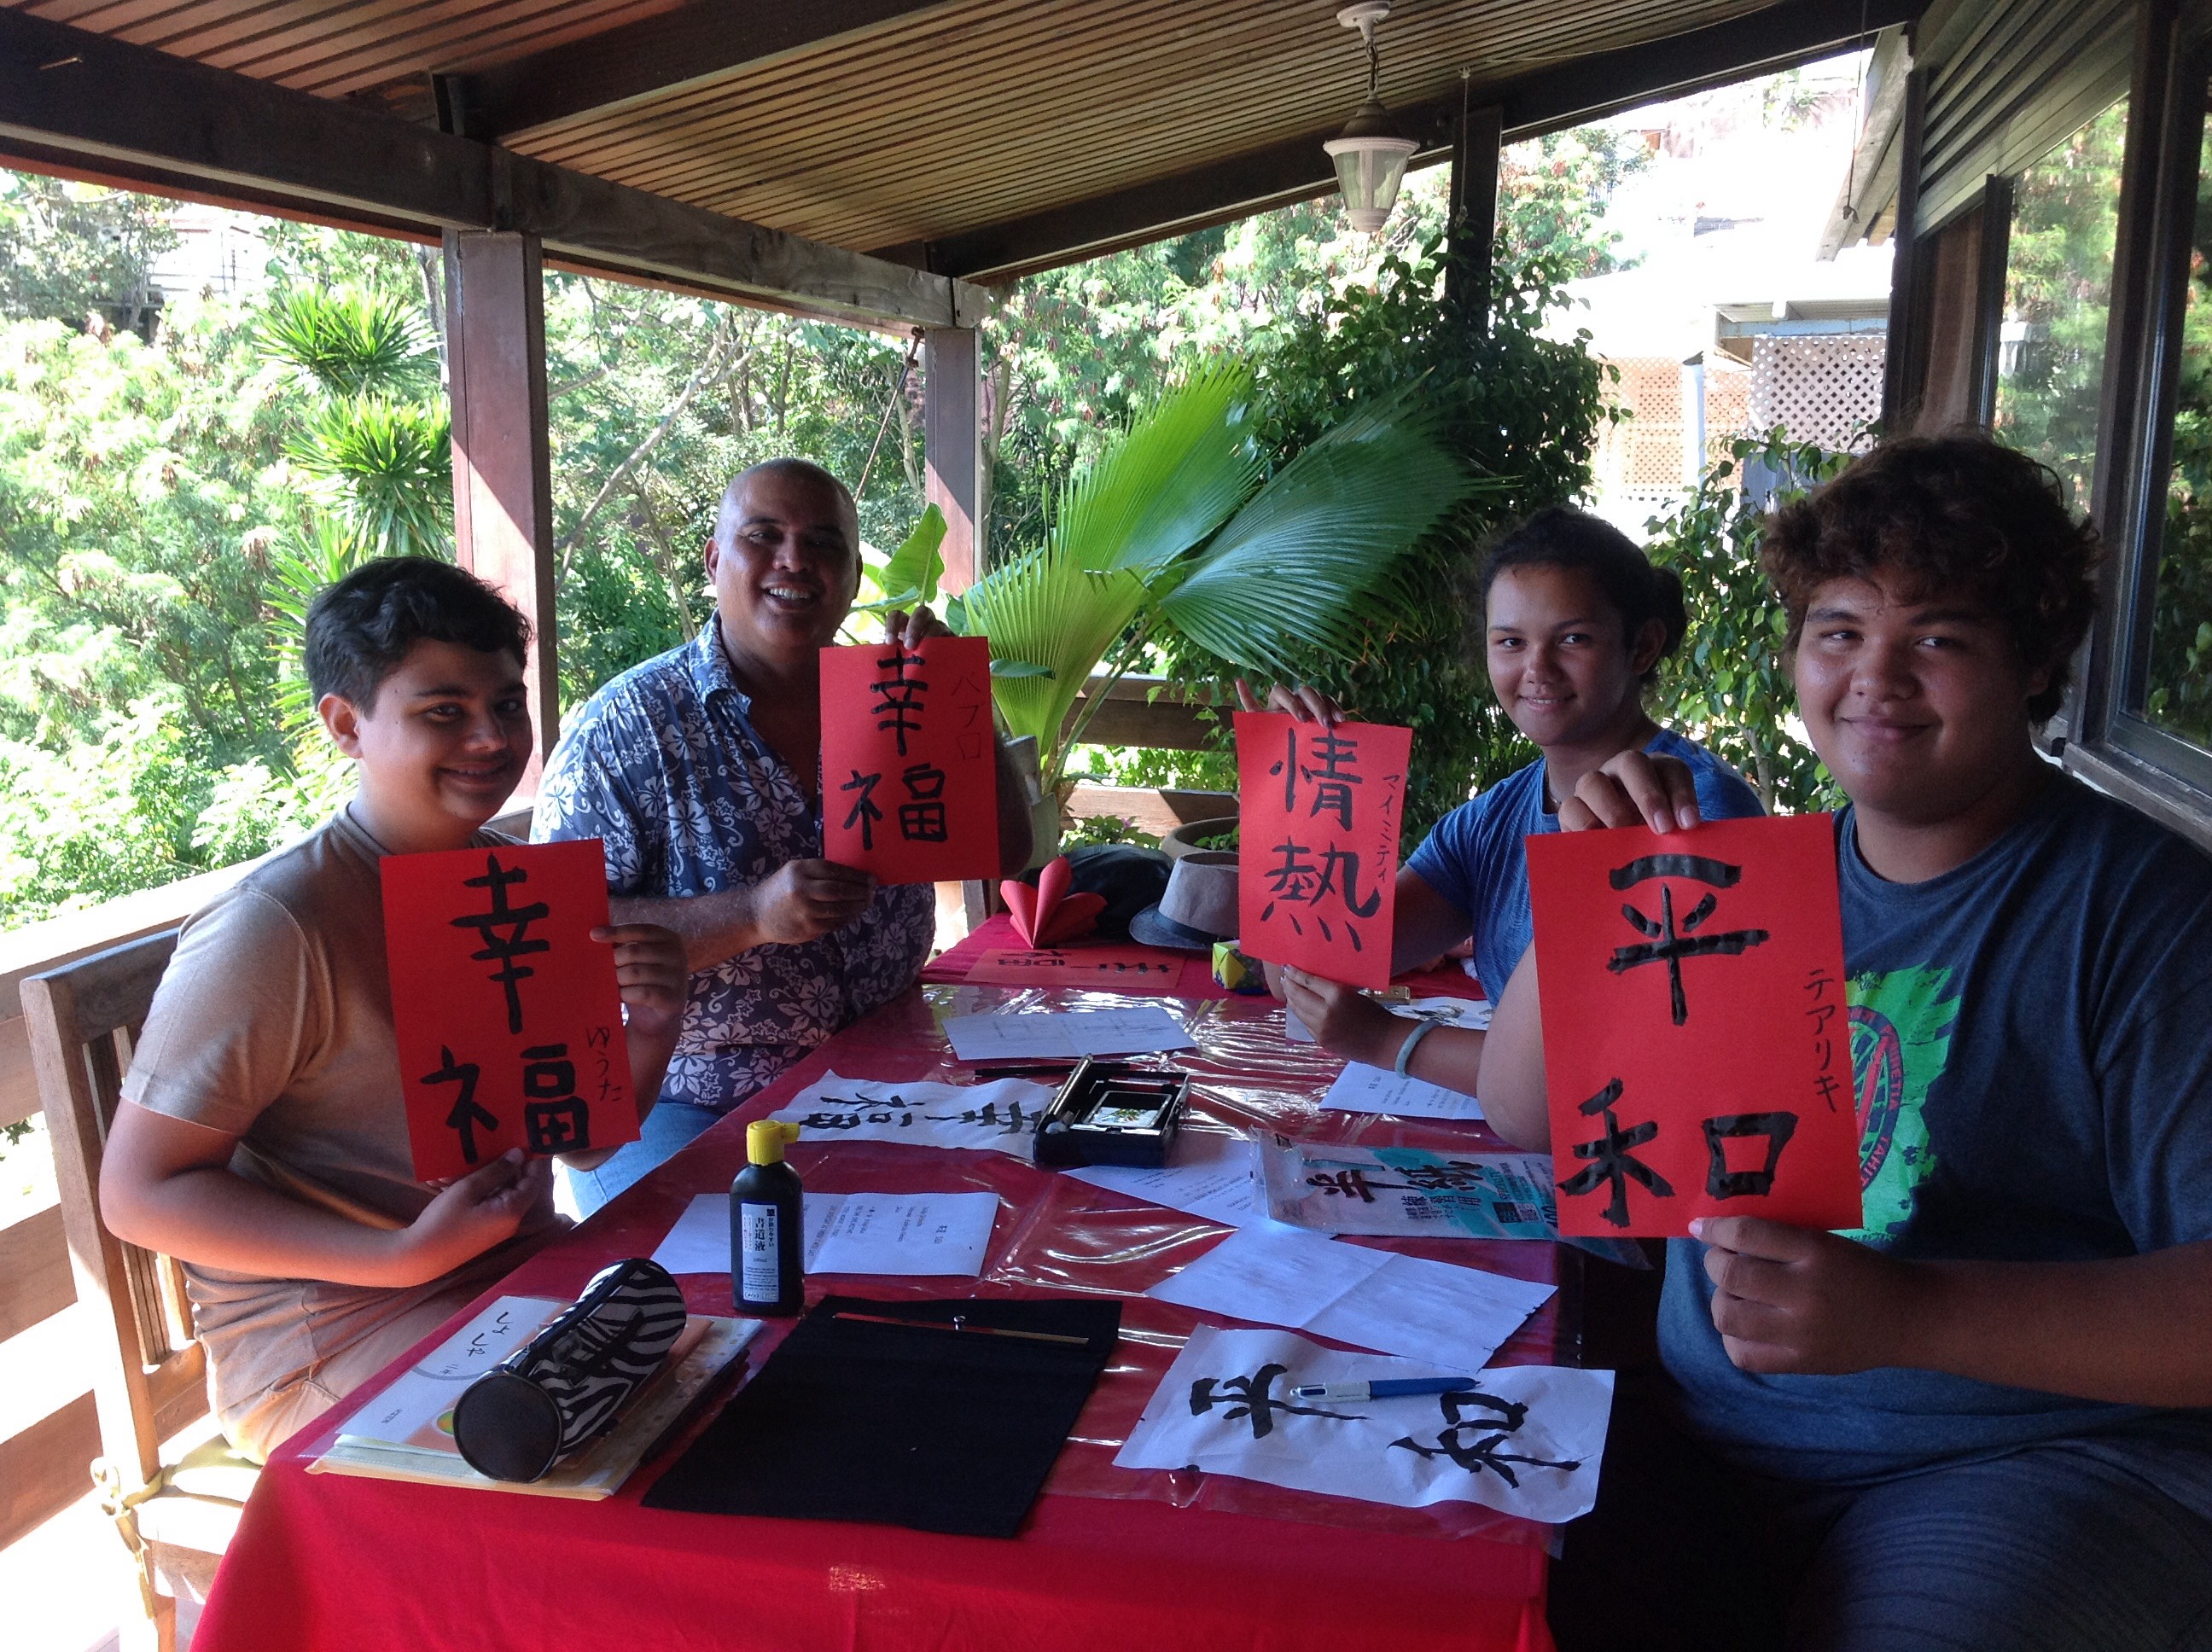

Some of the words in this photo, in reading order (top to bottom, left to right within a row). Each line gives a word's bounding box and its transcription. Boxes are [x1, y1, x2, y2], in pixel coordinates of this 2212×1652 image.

[840, 648, 948, 851] 幸福
[1260, 727, 1381, 952] 情熱
[420, 852, 591, 1164] 幸福
[585, 1026, 622, 1102] ゆうた
[1557, 854, 1798, 1228] 平和
[1804, 969, 1840, 1113] テアリキ
[1860, 1137, 1890, 1186] TAHIT
